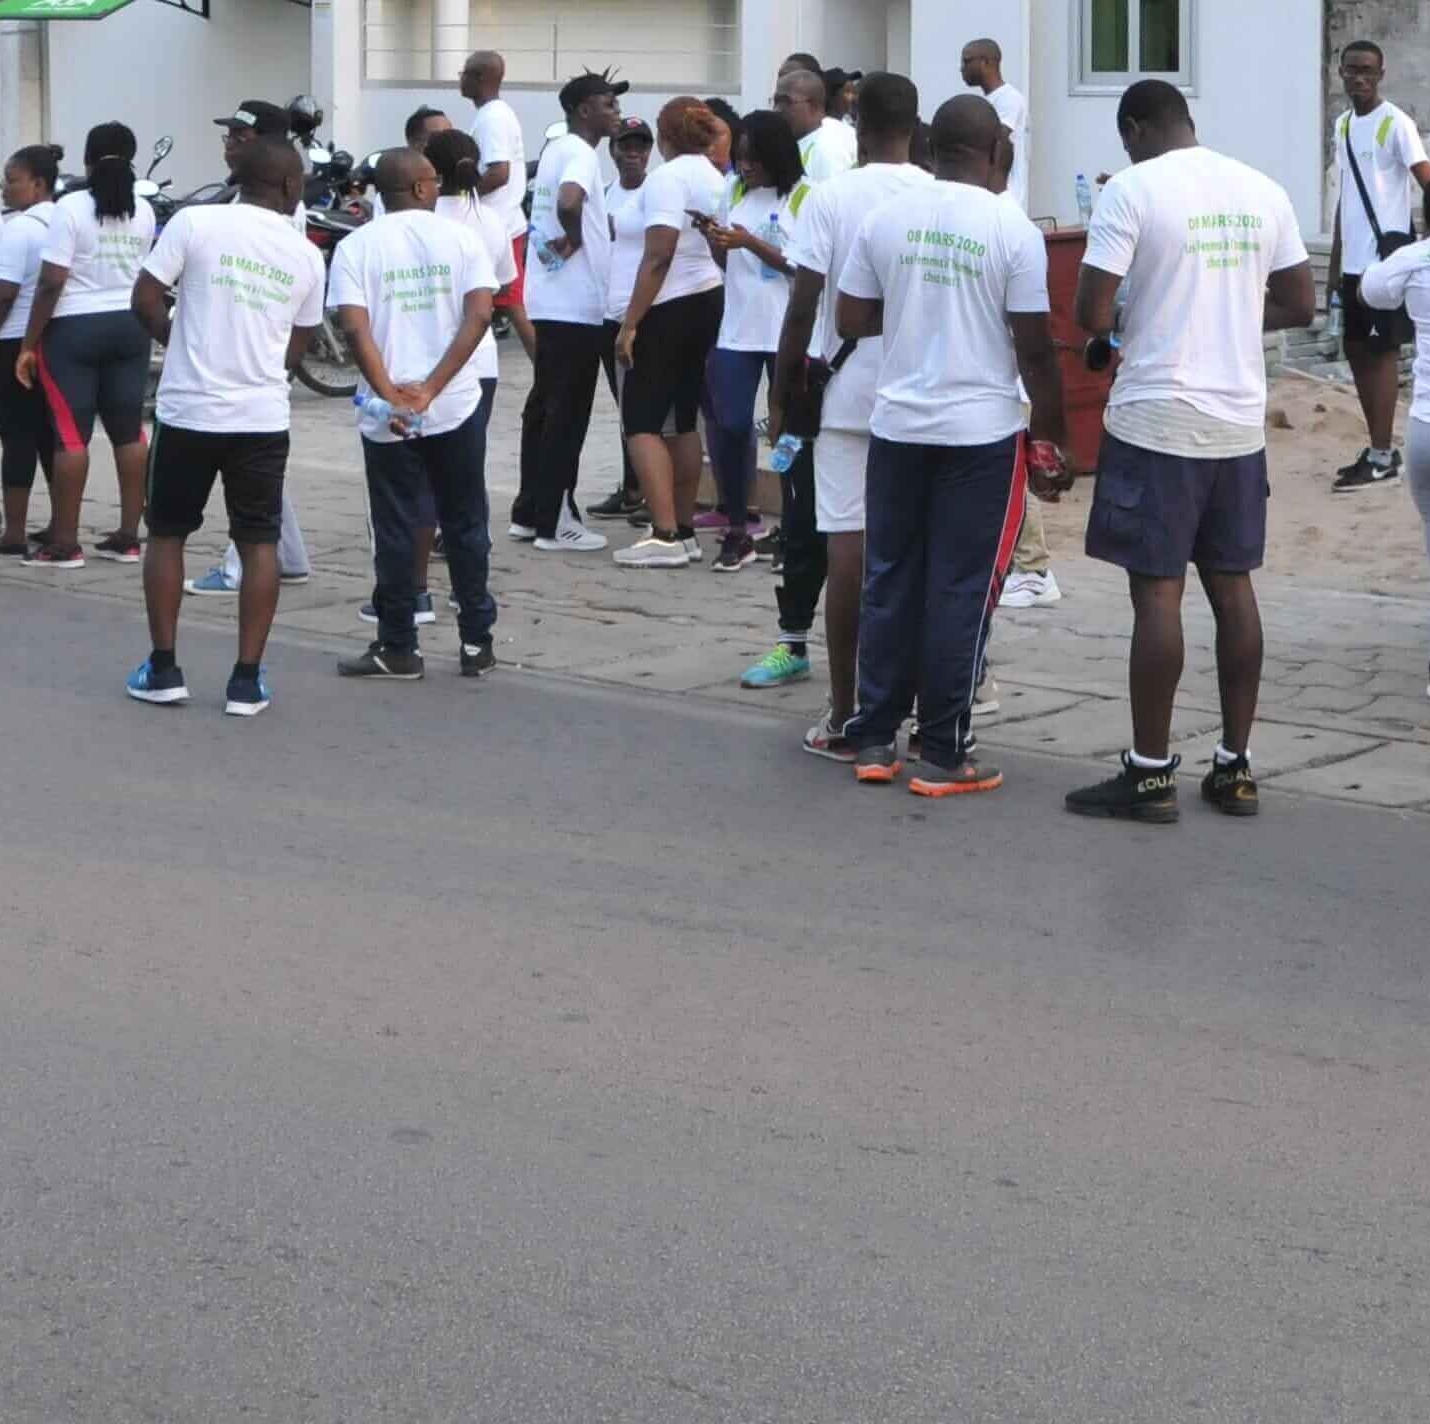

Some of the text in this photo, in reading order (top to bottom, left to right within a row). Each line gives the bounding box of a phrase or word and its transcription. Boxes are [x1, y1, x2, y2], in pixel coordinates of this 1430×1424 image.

[1201, 213, 1231, 229] MARS
[1234, 213, 1263, 229] 2020
[906, 228, 986, 257] 08 MARS 2020
[219, 253, 295, 286] 08 MARS 2020
[396, 266, 425, 280] MARS
[426, 264, 451, 277] 2020
